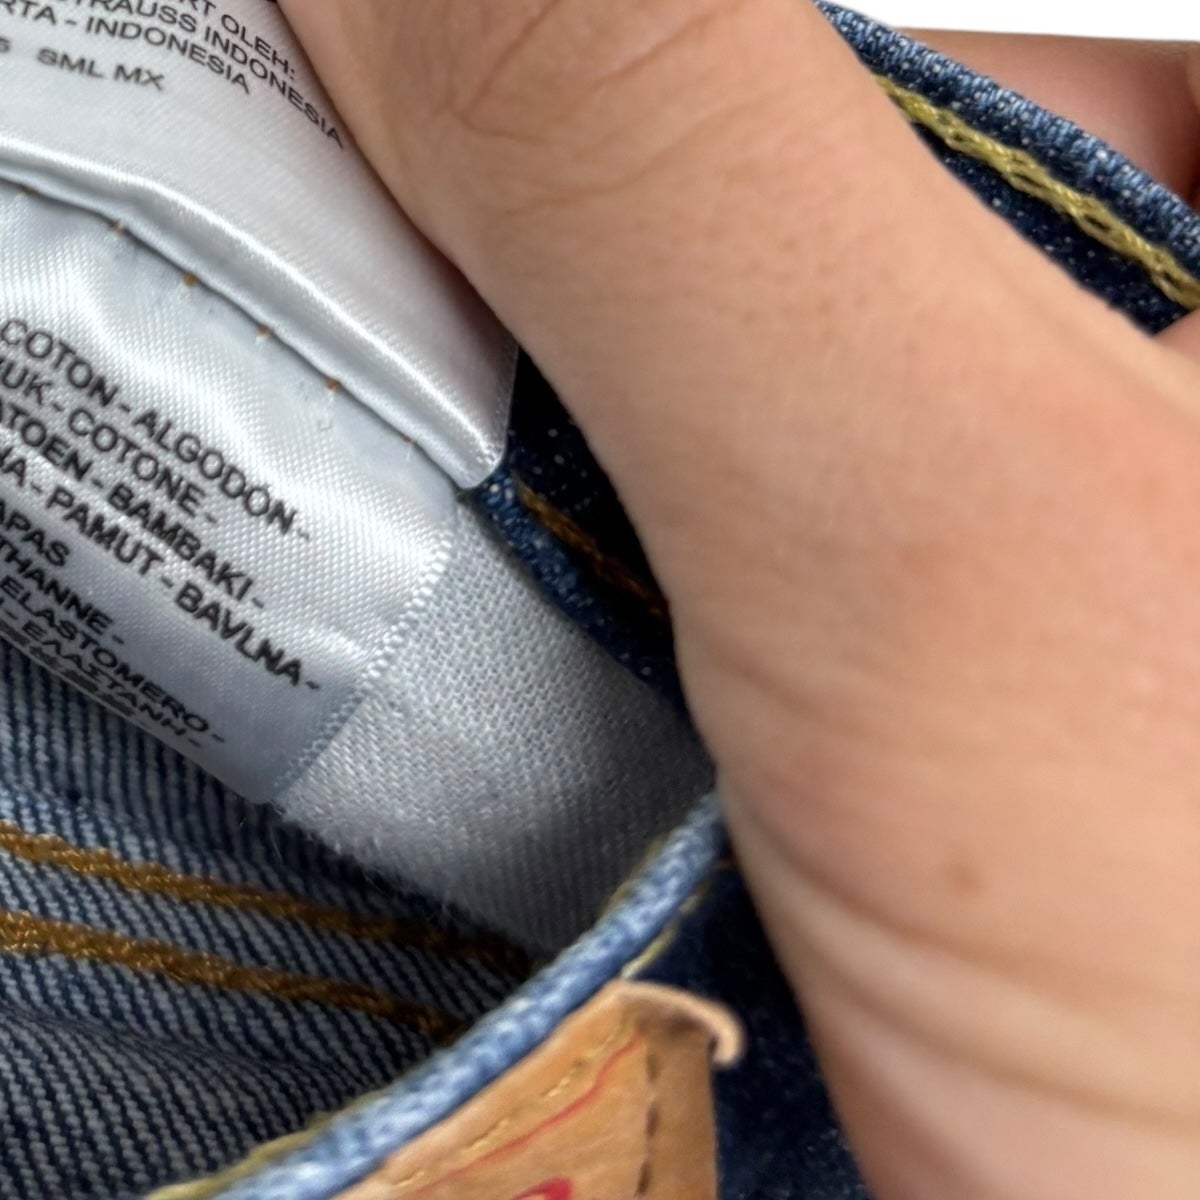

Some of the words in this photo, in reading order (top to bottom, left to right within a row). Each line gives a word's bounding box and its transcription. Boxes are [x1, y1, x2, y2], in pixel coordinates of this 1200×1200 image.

[36, 46, 105, 79] SML
[113, 64, 165, 92] MX
[86, 16, 250, 95] INDONESIA
[204, 26, 345, 150] INDONESIA
[220, 14, 296, 82] OLEH:
[0, 318, 120, 408] COTON
[132, 407, 297, 536] ALGODÓN
[68, 408, 206, 518] COTONE
[46, 486, 166, 577] PAMUT
[175, 580, 303, 687] BAVLNA
[0, 575, 210, 734] ELASTOMERO
